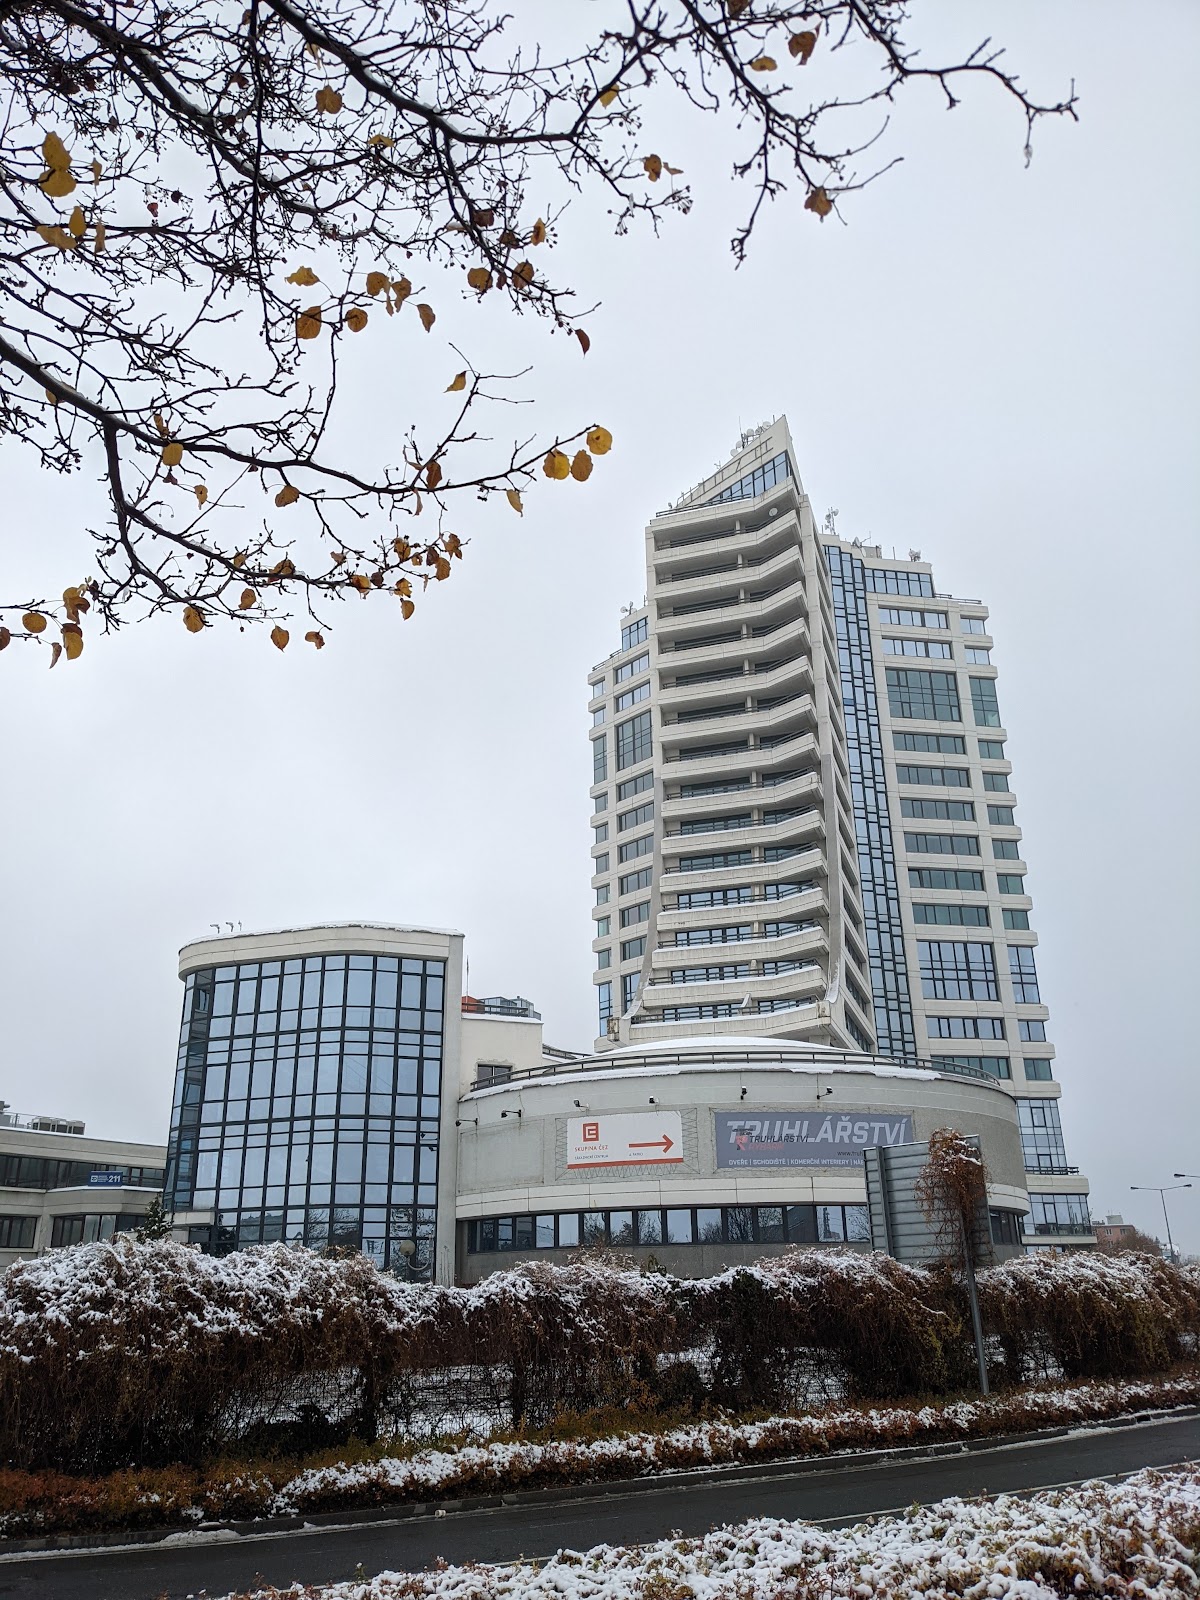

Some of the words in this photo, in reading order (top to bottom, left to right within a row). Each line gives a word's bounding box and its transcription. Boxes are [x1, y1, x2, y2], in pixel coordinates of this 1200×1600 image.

[727, 1115, 908, 1145] TRUHLÁŘSTVÍ
[749, 1133, 809, 1143] TRUHLÁŘSTVÍ
[752, 1157, 786, 1165] SCHODIŠTĚ
[790, 1157, 820, 1165] KOMERČNÍ
